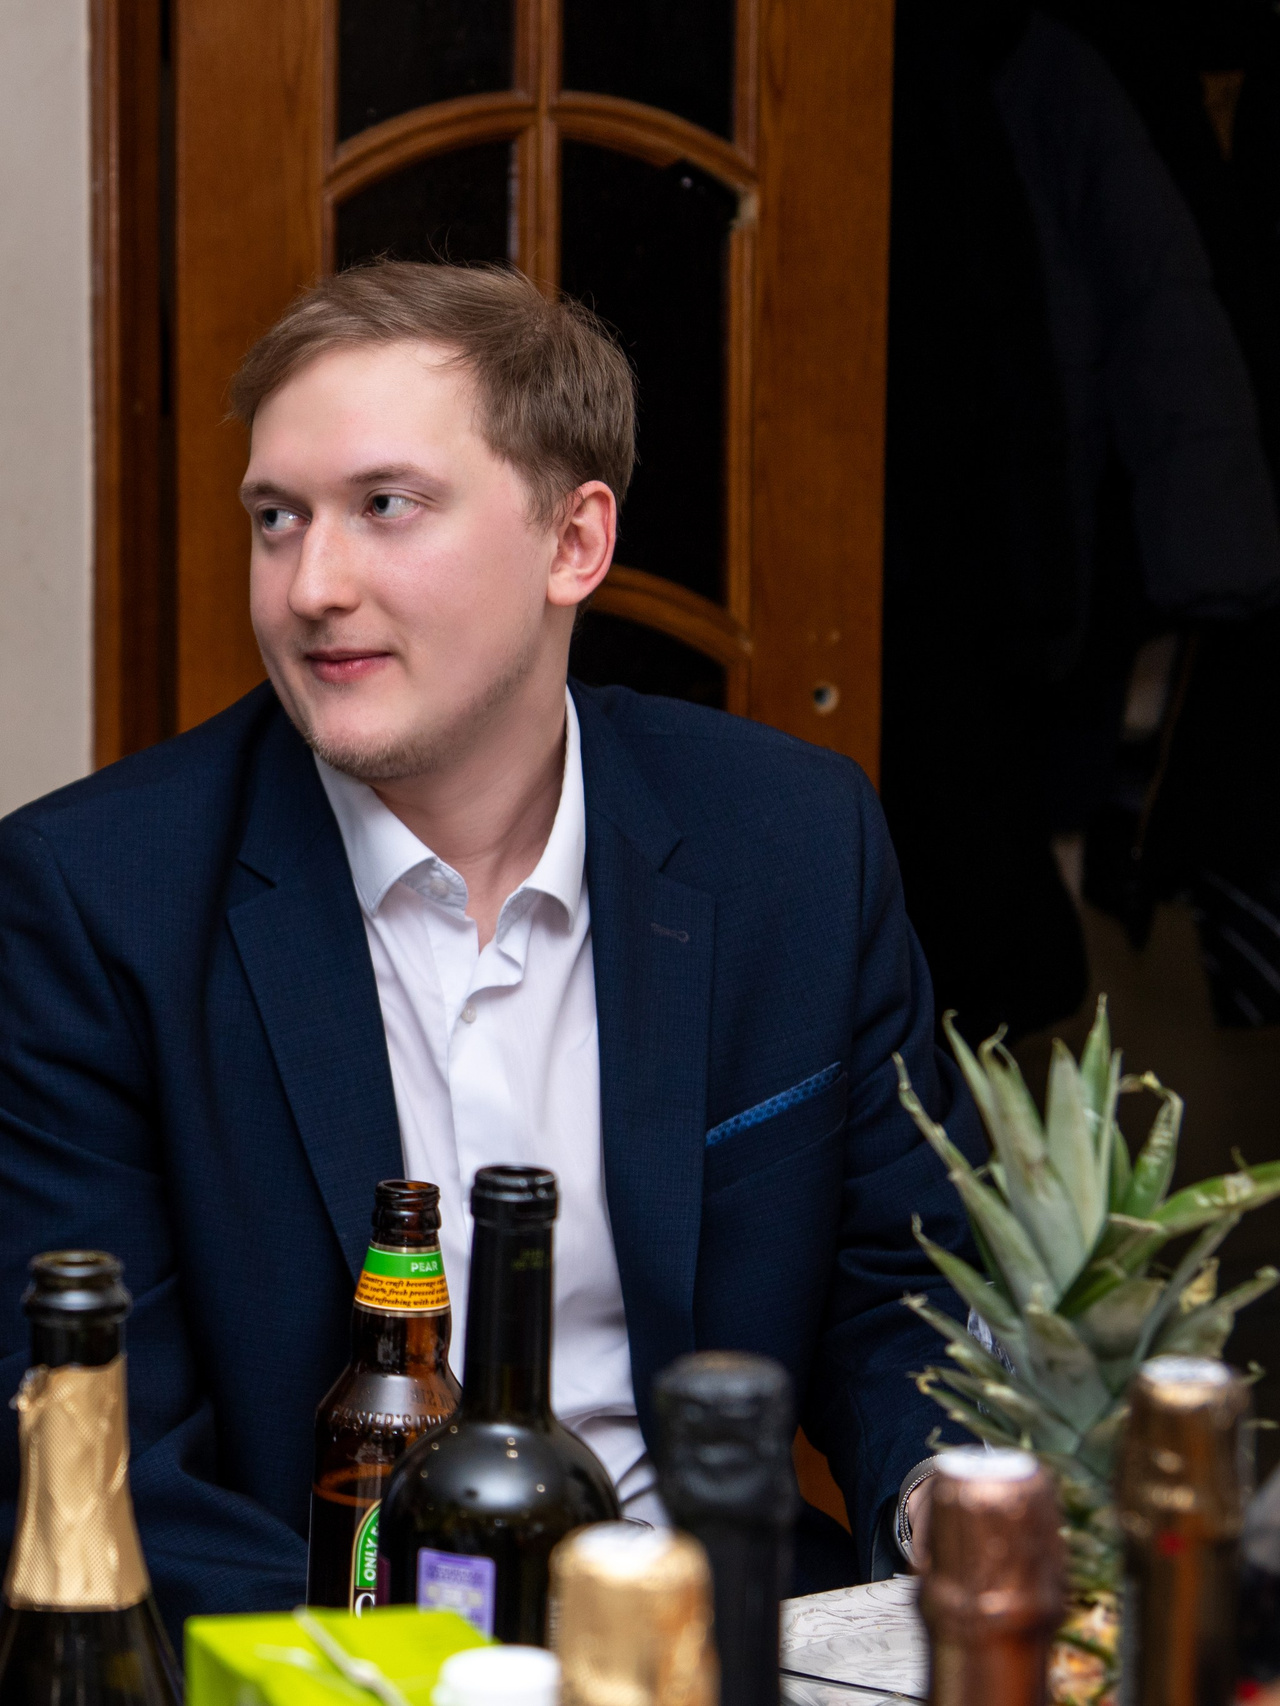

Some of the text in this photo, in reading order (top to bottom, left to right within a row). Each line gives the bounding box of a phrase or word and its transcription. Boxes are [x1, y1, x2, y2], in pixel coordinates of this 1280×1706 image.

[411, 1261, 438, 1273] PEAR
[363, 1273, 384, 1286] Country
[386, 1280, 404, 1289] craft
[406, 1280, 436, 1289] beverage
[388, 1288, 408, 1297] fresh
[409, 1288, 435, 1298] pressed
[375, 1296, 411, 1308] refreshing
[413, 1298, 429, 1306] with
[363, 1537, 379, 1582] ONLY
